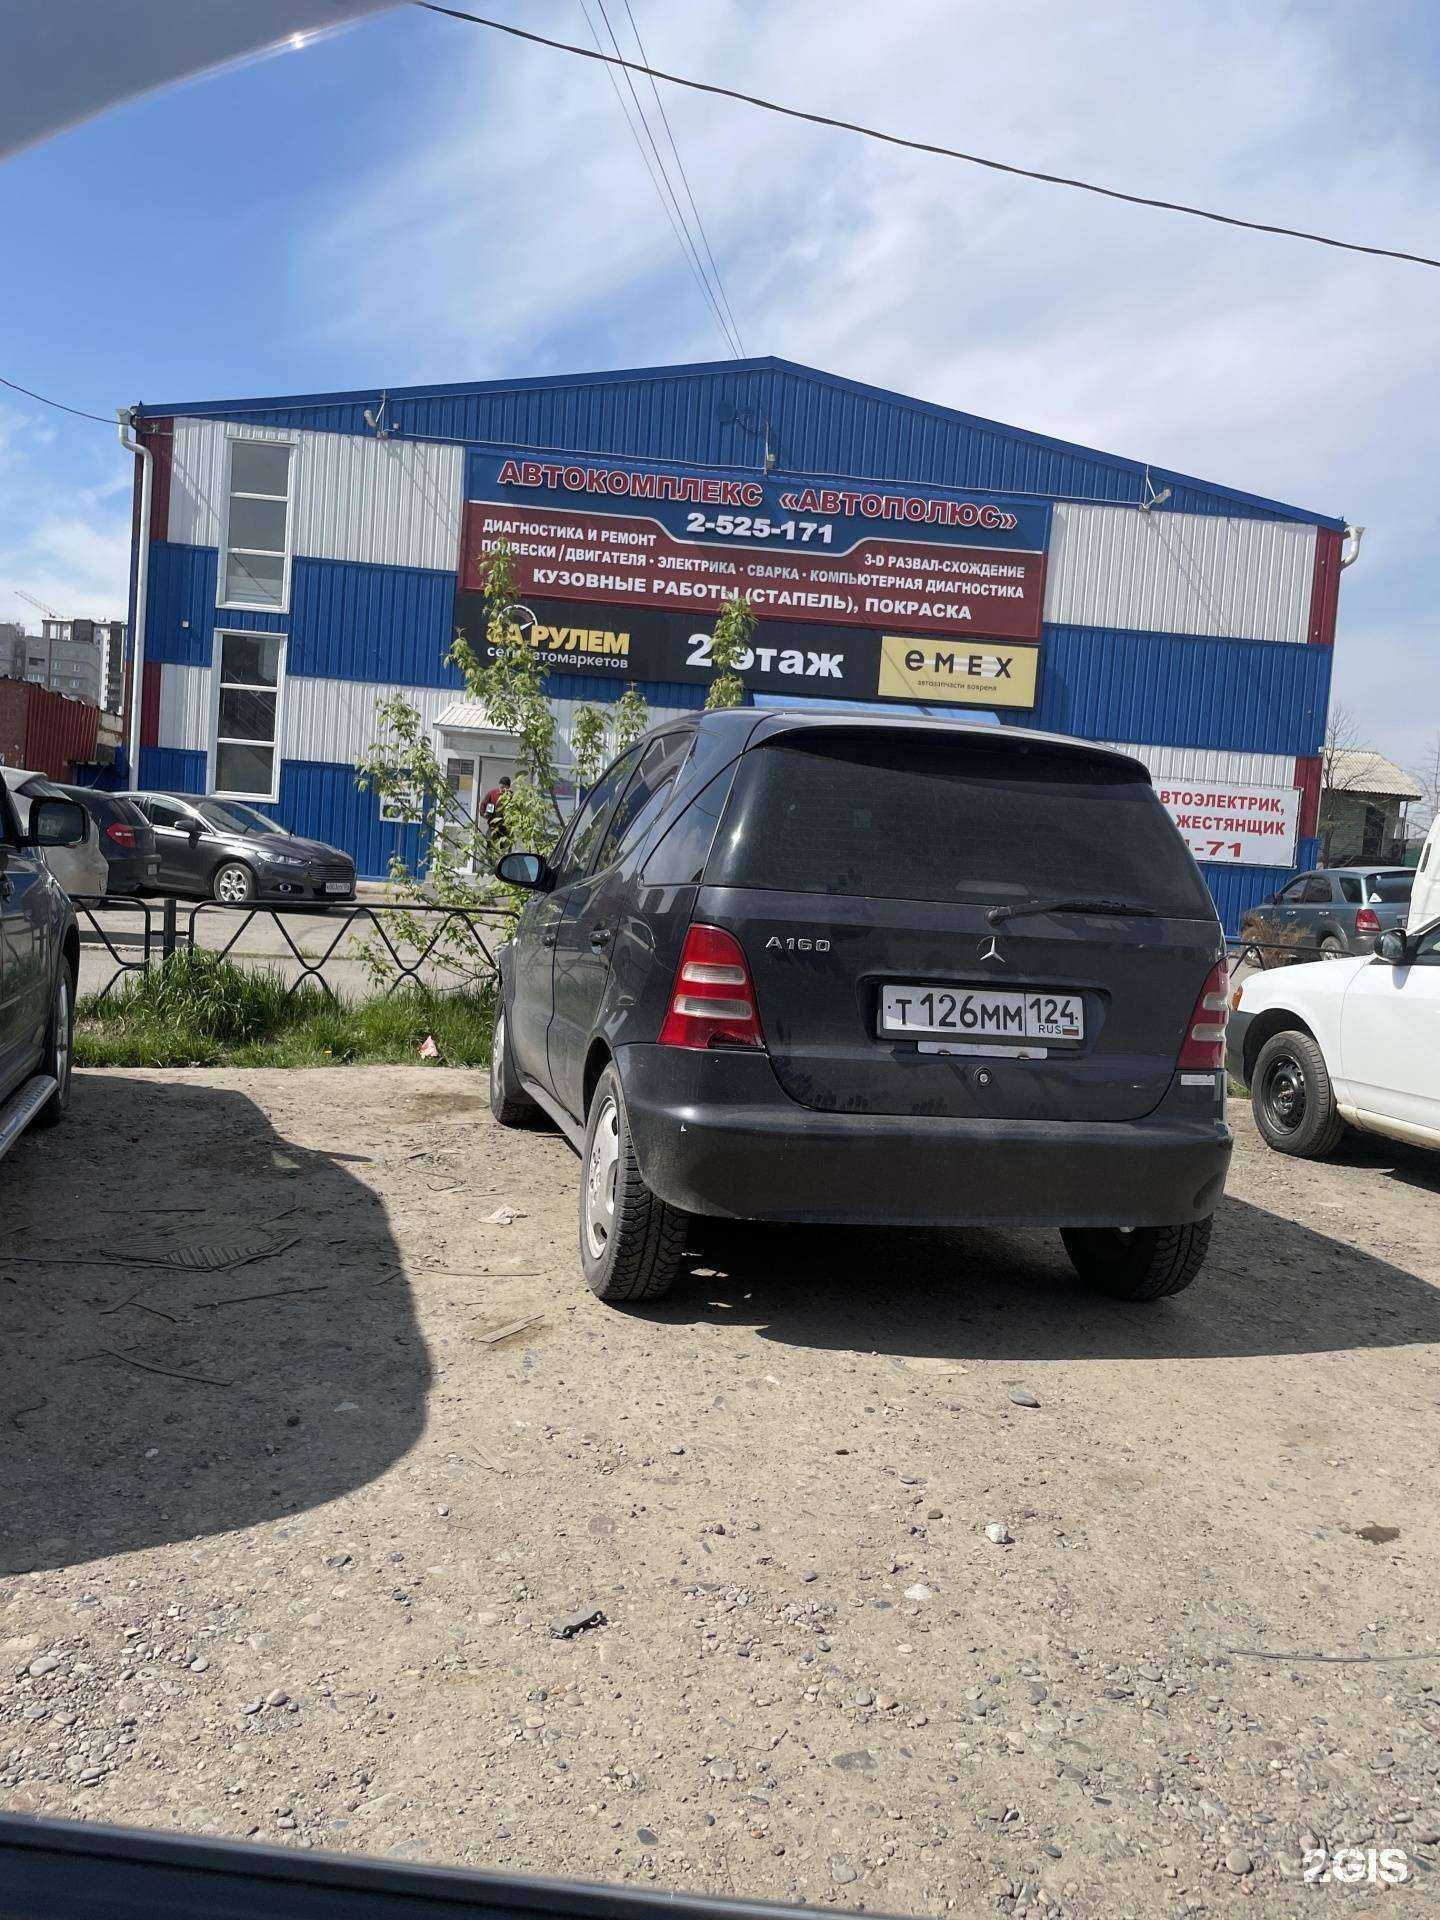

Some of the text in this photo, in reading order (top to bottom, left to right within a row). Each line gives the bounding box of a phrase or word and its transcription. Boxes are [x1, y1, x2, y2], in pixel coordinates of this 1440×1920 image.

[498, 460, 1018, 530] АВТОКОМПЛЕКС «АВТОПОЛЮС»
[482, 518, 656, 547] ДИАГНОСТИКА И РЕМОНТ
[686, 512, 833, 544] 2-525-171
[657, 556, 736, 575] ЭЛЕКТРИКА
[747, 564, 799, 580] СВАРКА
[810, 569, 923, 591] КОМПЬЮТЕРНАЯ
[925, 580, 1025, 598] ДИАГНОСТИКА
[888, 556, 1025, 579] РАЗВАЛ-СХОЖДЕНИЕ
[533, 568, 972, 620] КУЗОВНЫЕ РАБОТЫ (СТАПЕЛЬ), ПОКРАСКА
[530, 624, 630, 655] РУЛЕМ
[686, 633, 844, 679] 2 этаж
[1155, 790, 1285, 815] ВТОЭЛЕКТРИК,
[1176, 814, 1286, 837] ЖЕСТЯНЩИК
[765, 936, 831, 952] A160
[1029, 998, 1076, 1025] 124
[1038, 1024, 1062, 1035] RUS
